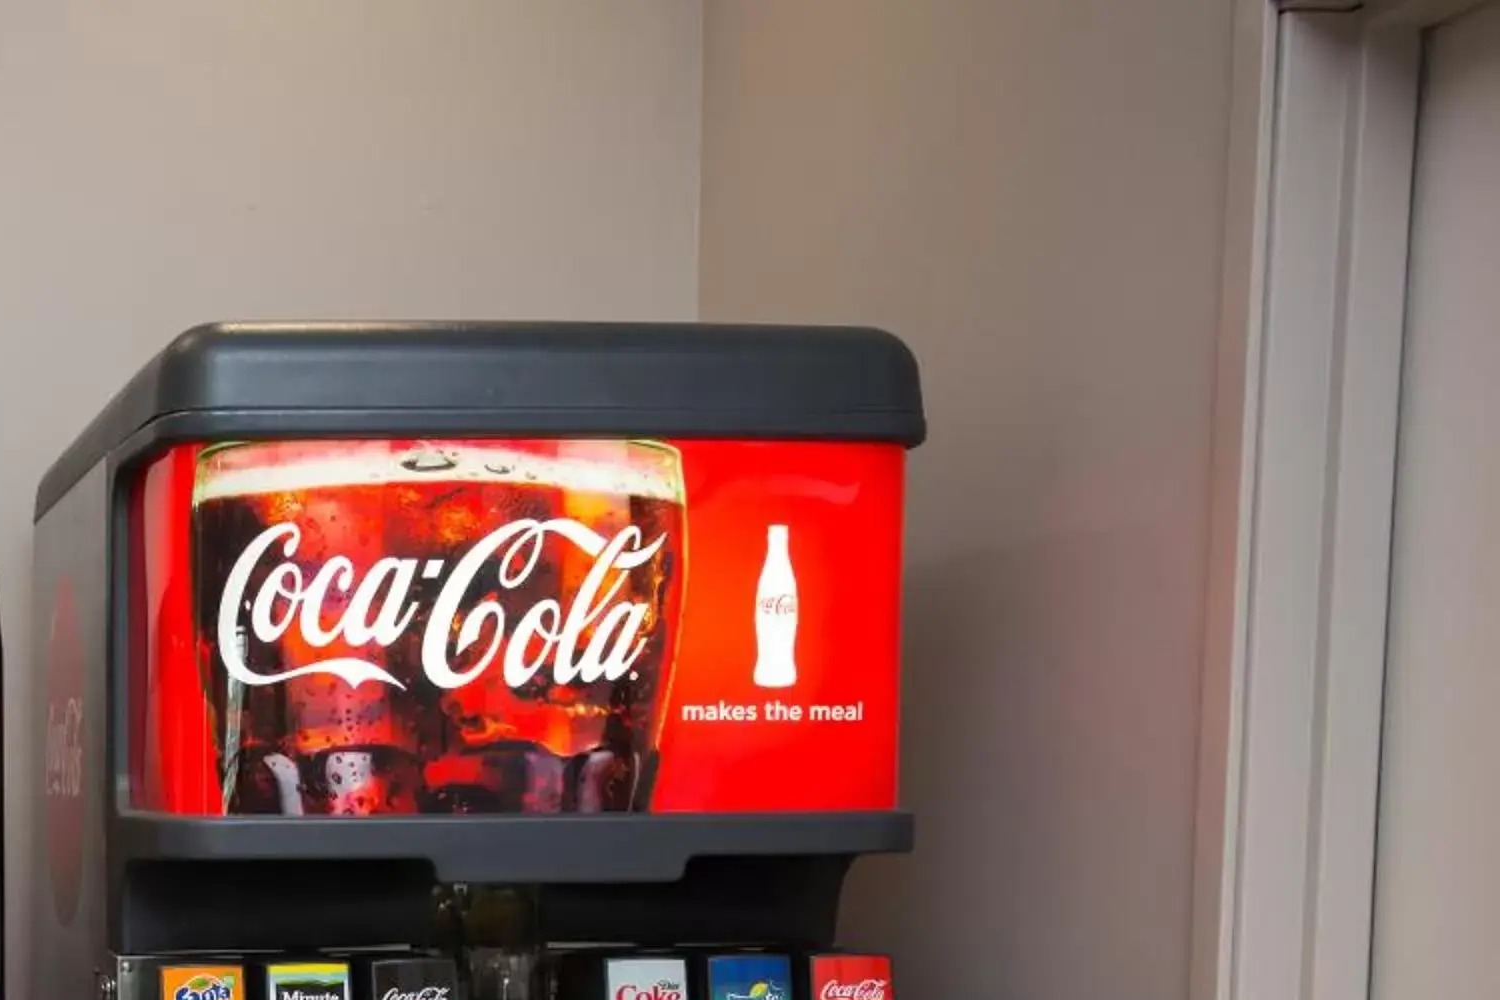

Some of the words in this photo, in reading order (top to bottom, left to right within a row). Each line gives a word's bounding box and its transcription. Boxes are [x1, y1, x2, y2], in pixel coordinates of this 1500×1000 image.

[217, 517, 667, 691] Coca-Cola
[682, 701, 757, 721] makes
[764, 701, 802, 721] the
[809, 702, 863, 721] meal
